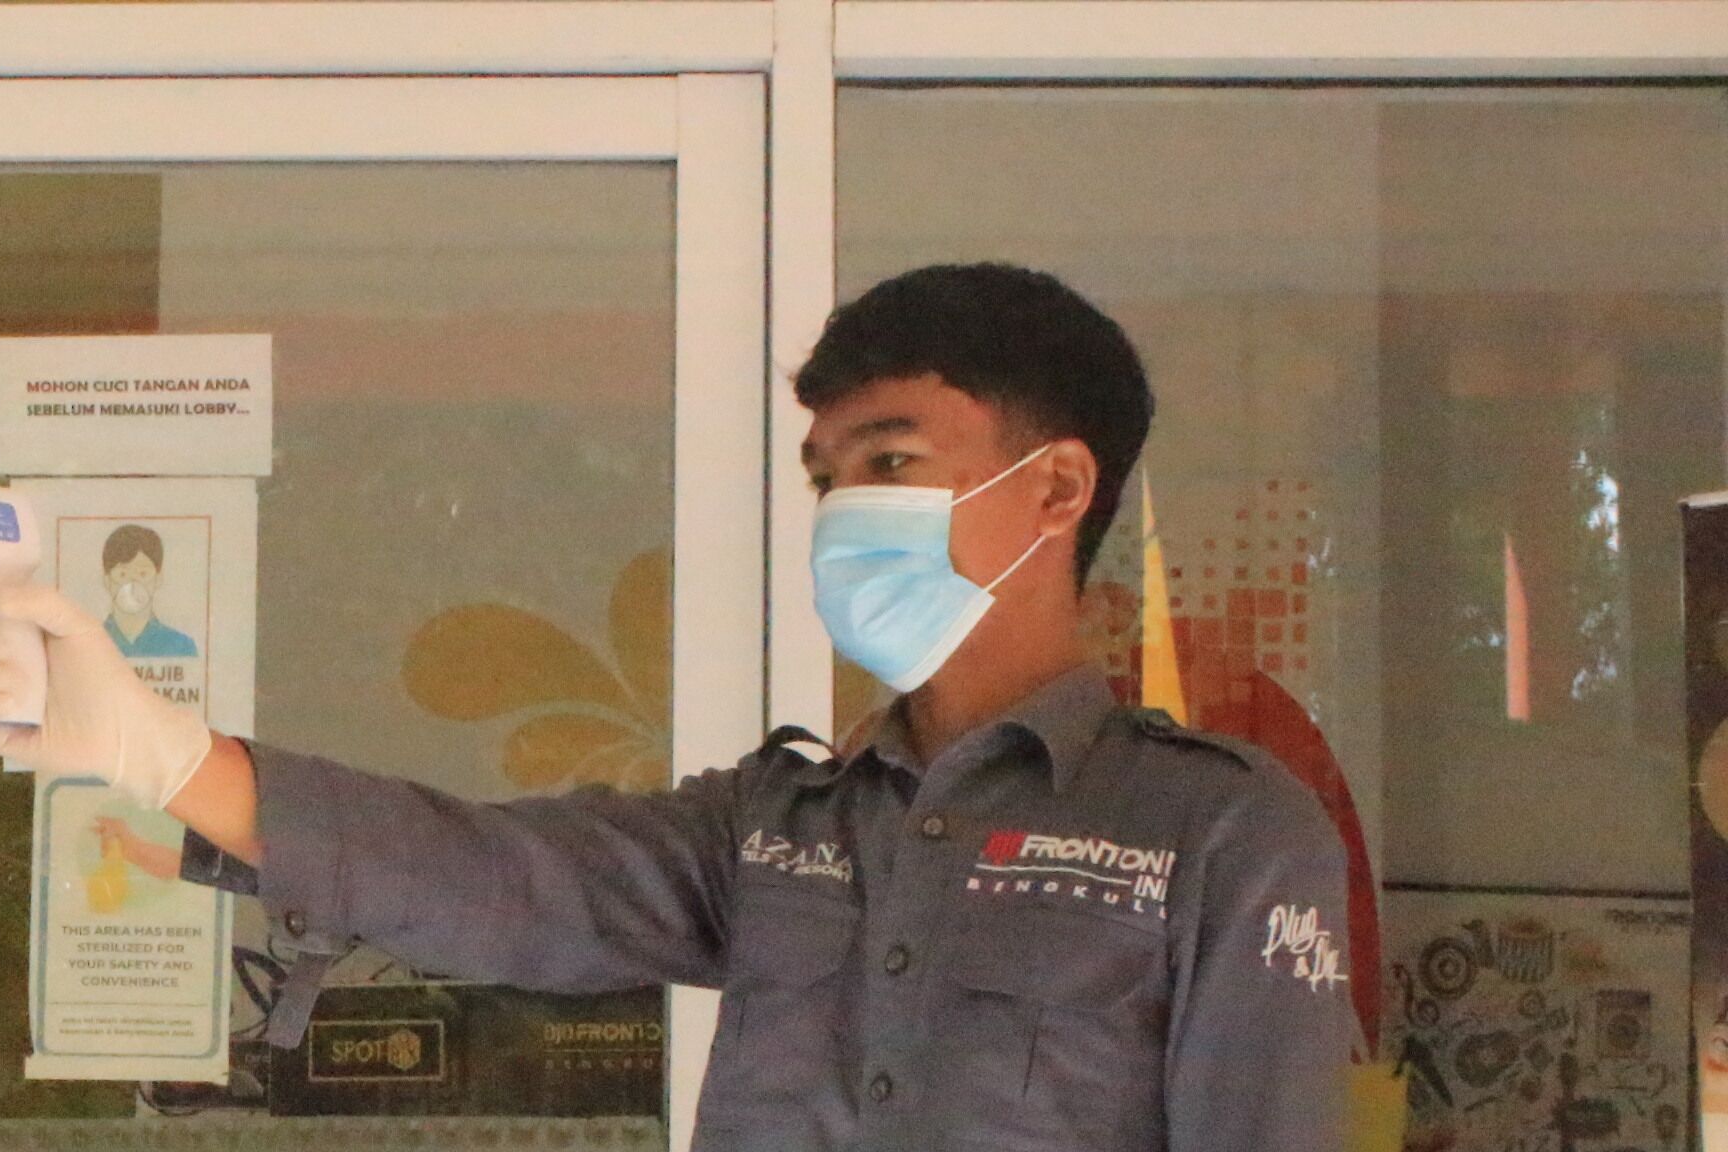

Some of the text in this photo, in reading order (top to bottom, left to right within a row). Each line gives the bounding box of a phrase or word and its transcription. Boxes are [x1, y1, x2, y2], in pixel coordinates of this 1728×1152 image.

[26, 378, 250, 393] MOHON CUCI TANGAN ANDA
[26, 403, 95, 416] SEBELUM
[99, 403, 180, 416] MEMASUKI
[62, 925, 202, 938] THIS AREA HAS BEEN
[1261, 903, 1331, 968] Plug
[76, 942, 185, 954] STERILIZED FOR
[68, 959, 193, 971] YOUR SAFETY AND
[80, 975, 180, 988] CONVENIENCE
